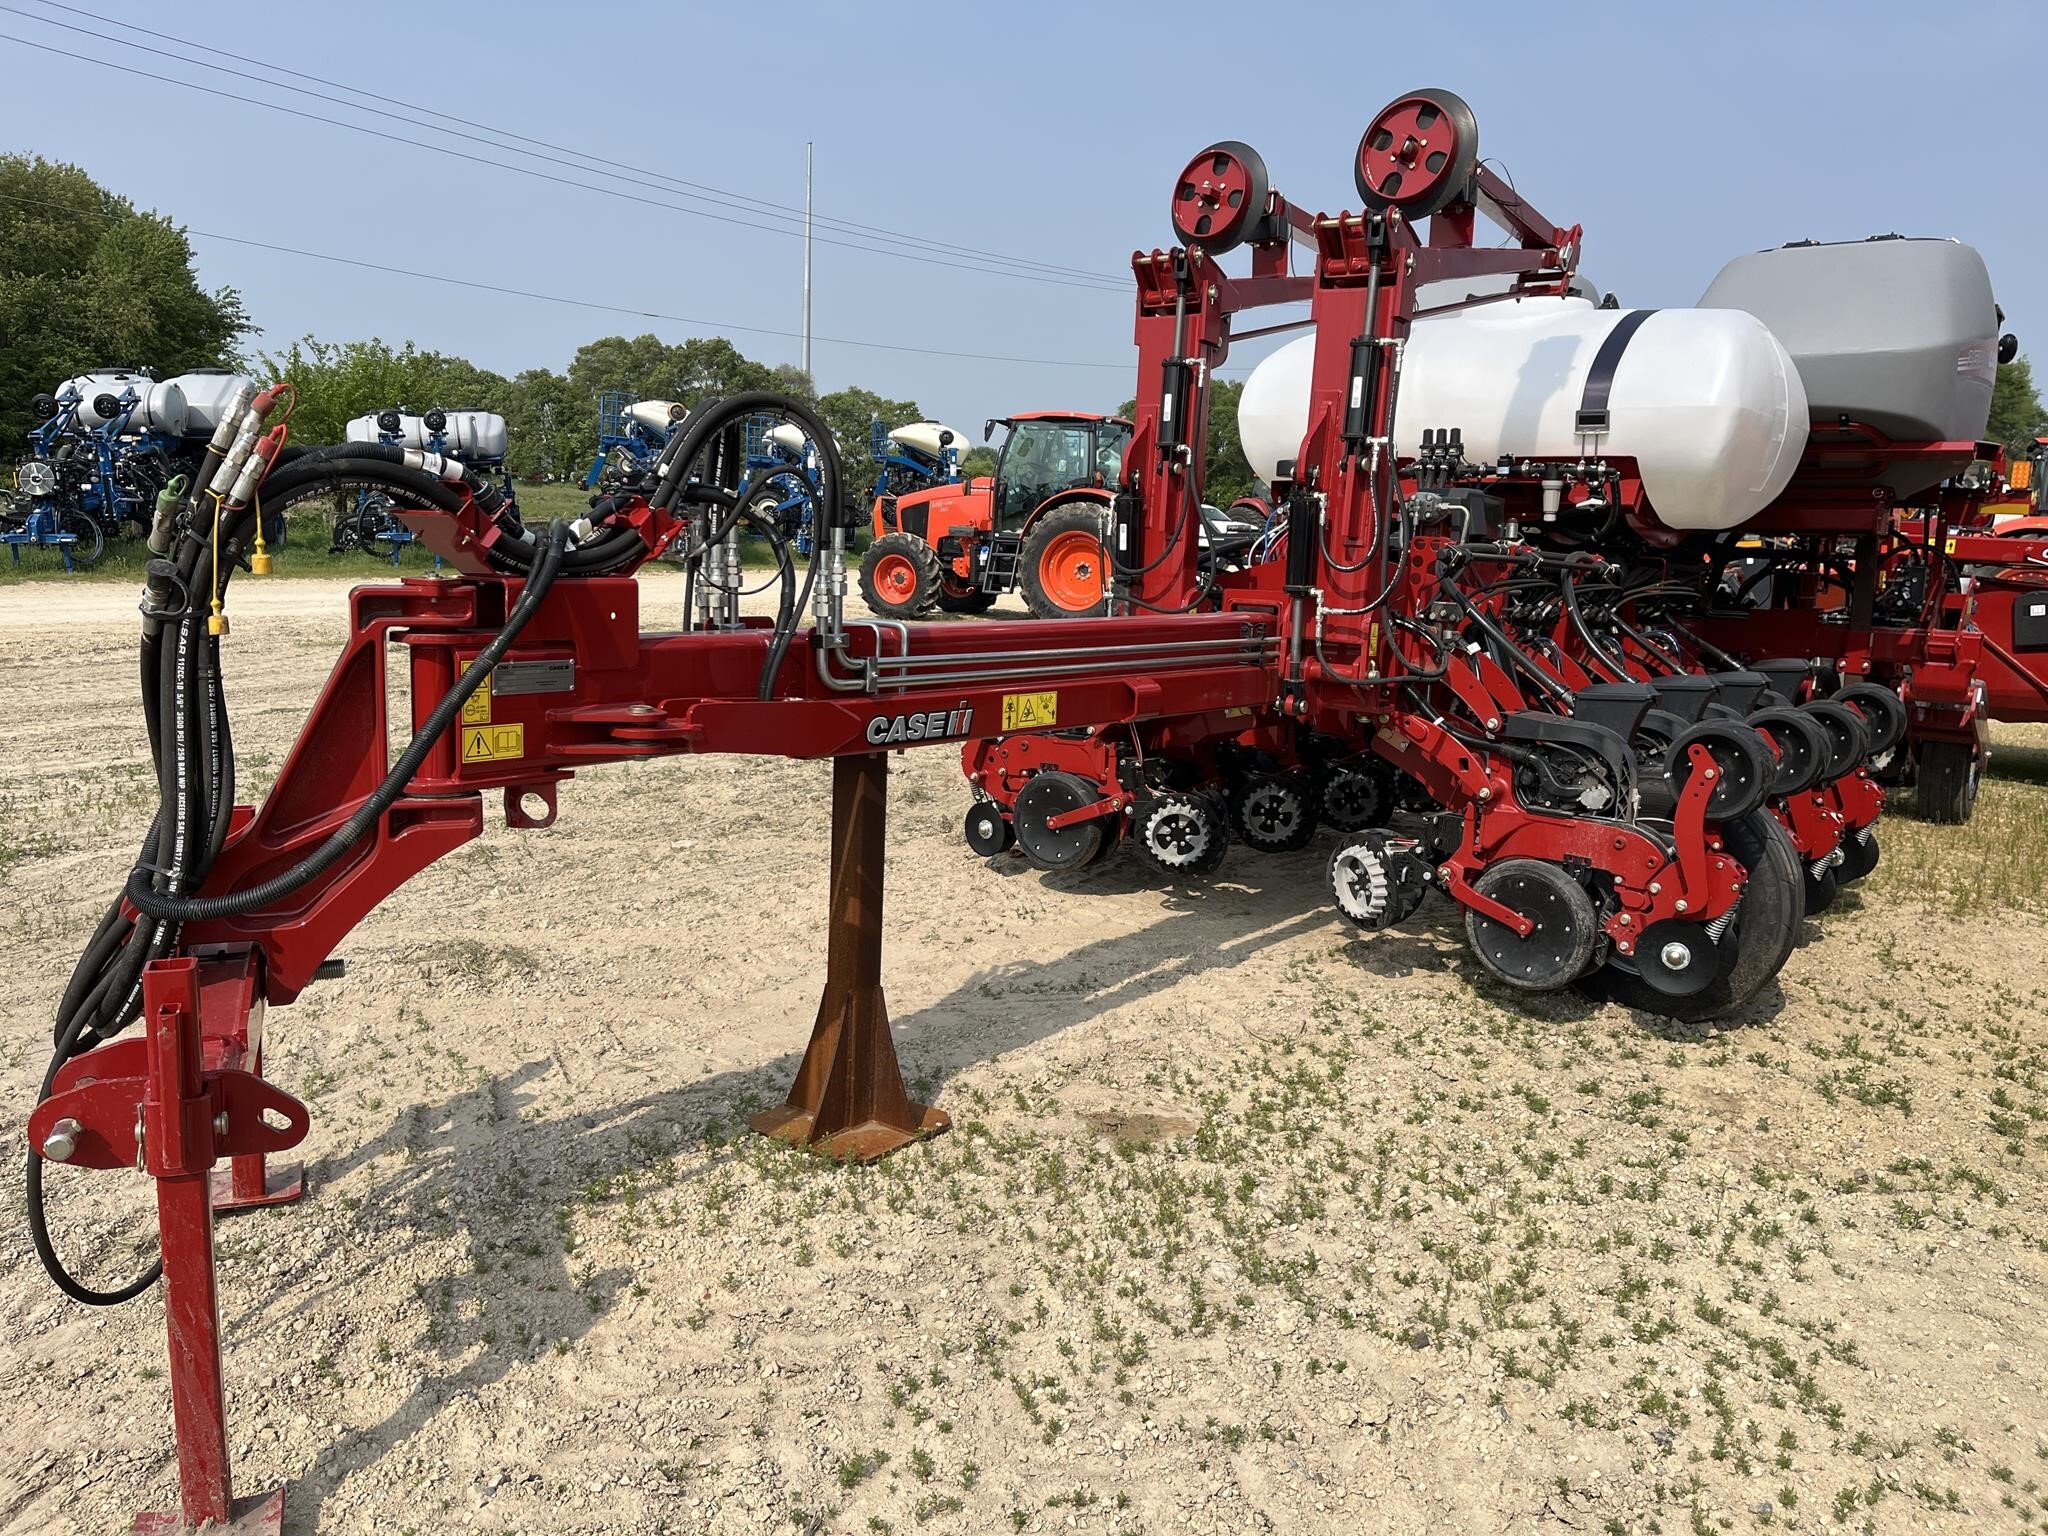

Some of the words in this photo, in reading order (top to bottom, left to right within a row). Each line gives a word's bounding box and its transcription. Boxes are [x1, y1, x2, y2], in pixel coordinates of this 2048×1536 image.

[176, 711, 185, 729] 3600
[866, 711, 947, 745] CASE
[177, 730, 185, 742] PSI
[177, 747, 186, 761] 250
[178, 762, 186, 776] BAR
[178, 777, 186, 789] WP
[178, 792, 186, 820] EXCEEDS
[177, 821, 186, 834] SAE
[174, 835, 184, 861] 100R17
